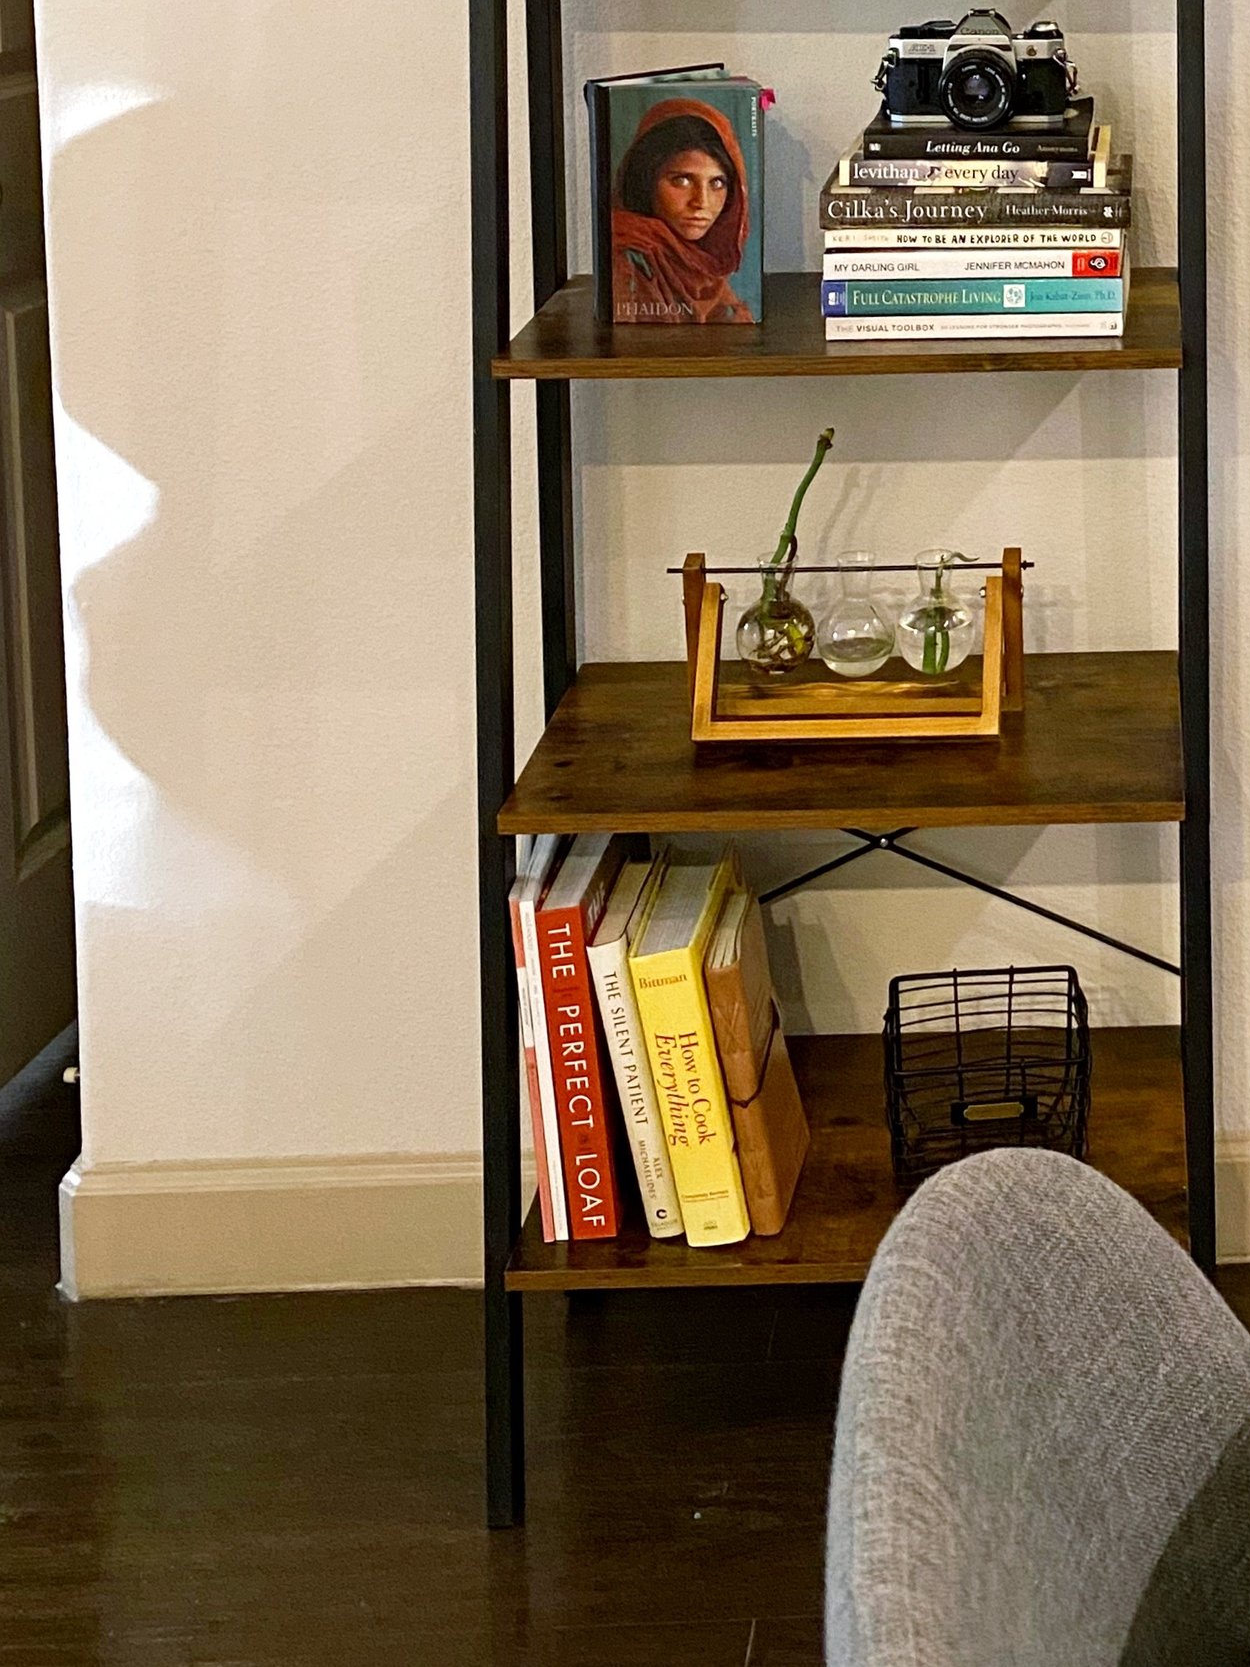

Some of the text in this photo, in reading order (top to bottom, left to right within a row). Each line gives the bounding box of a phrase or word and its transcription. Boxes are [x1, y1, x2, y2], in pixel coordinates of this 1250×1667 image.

[960, 26, 999, 35] Canon
[926, 140, 1021, 154] Letting Ana Go
[853, 163, 919, 179] levithan
[944, 164, 1019, 183] every day
[827, 199, 988, 224] Cilka's Journey
[1005, 205, 1088, 215] Heather Morris
[896, 235, 918, 243] HOW
[935, 235, 947, 244] BE
[951, 235, 966, 243] AN
[970, 234, 1019, 243] EXPLORER
[1023, 234, 1035, 243] OF
[1039, 234, 1058, 243] THE
[1061, 234, 1097, 242] WORLD
[834, 263, 920, 272] MY DARLING GIRL
[964, 261, 1065, 271] JENNIFER MCMAHON
[853, 290, 880, 305] FULL
[882, 290, 959, 305] CATASTROPHE
[962, 289, 1001, 304] LIVING
[616, 301, 694, 316] PHAIDON
[856, 324, 888, 332] VISUAL
[638, 974, 688, 989] Bittman
[603, 971, 649, 1125] THE SILENT PATIENT
[548, 923, 606, 1226] THE PERFECT LOAF
[654, 1033, 690, 1147] Everything
[678, 1030, 716, 1145] How to Cook
